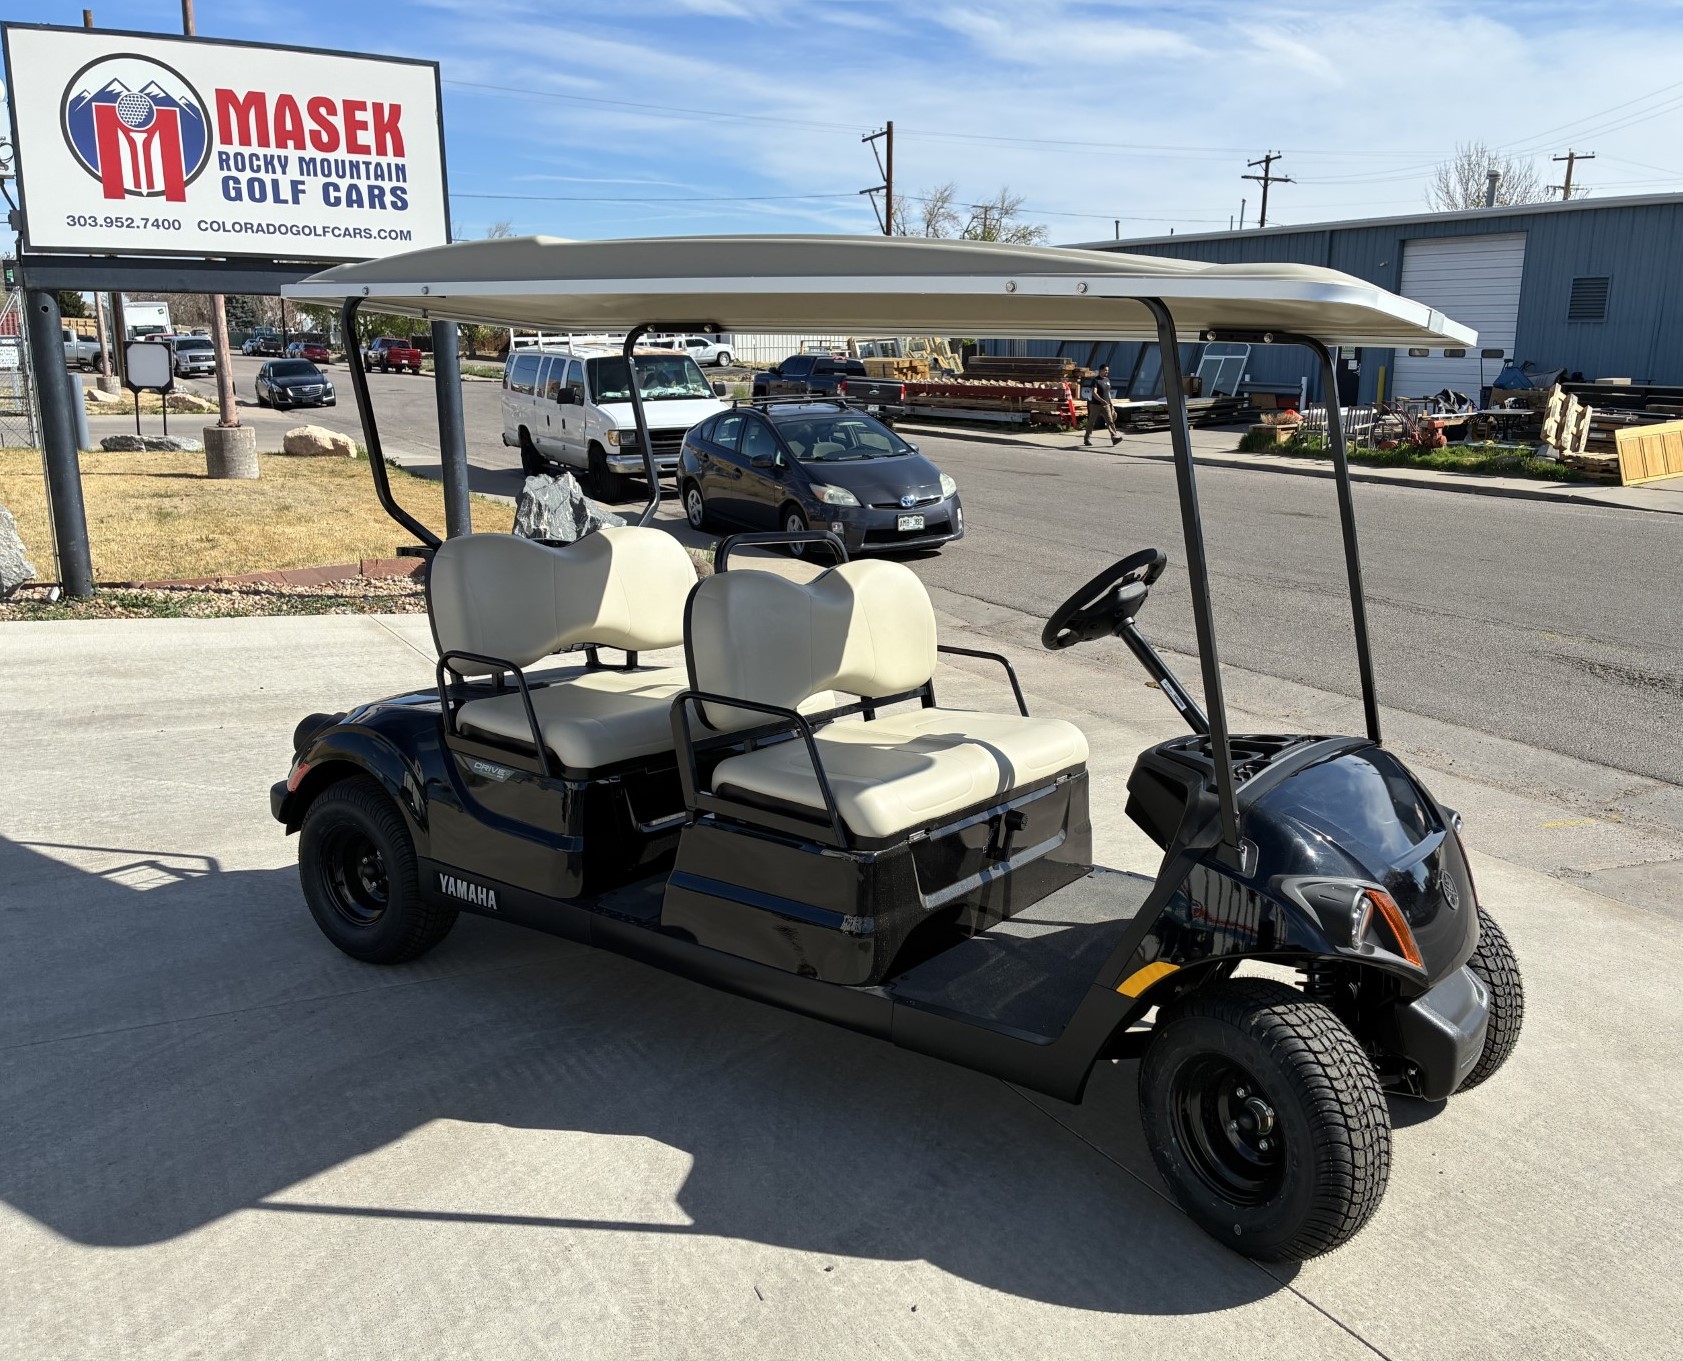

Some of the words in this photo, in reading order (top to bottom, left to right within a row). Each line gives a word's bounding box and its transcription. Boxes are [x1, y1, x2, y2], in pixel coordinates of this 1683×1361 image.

[214, 88, 405, 158] MASEK
[218, 151, 289, 175] ROCKY
[298, 156, 407, 183] MOUNTAIN
[221, 175, 306, 205] GOLF
[322, 181, 409, 211] CARS
[66, 215, 182, 230] 303.952.7400
[197, 219, 412, 241] COLORADOGOLFCARS.COM
[439, 873, 497, 910] YAMAHA
